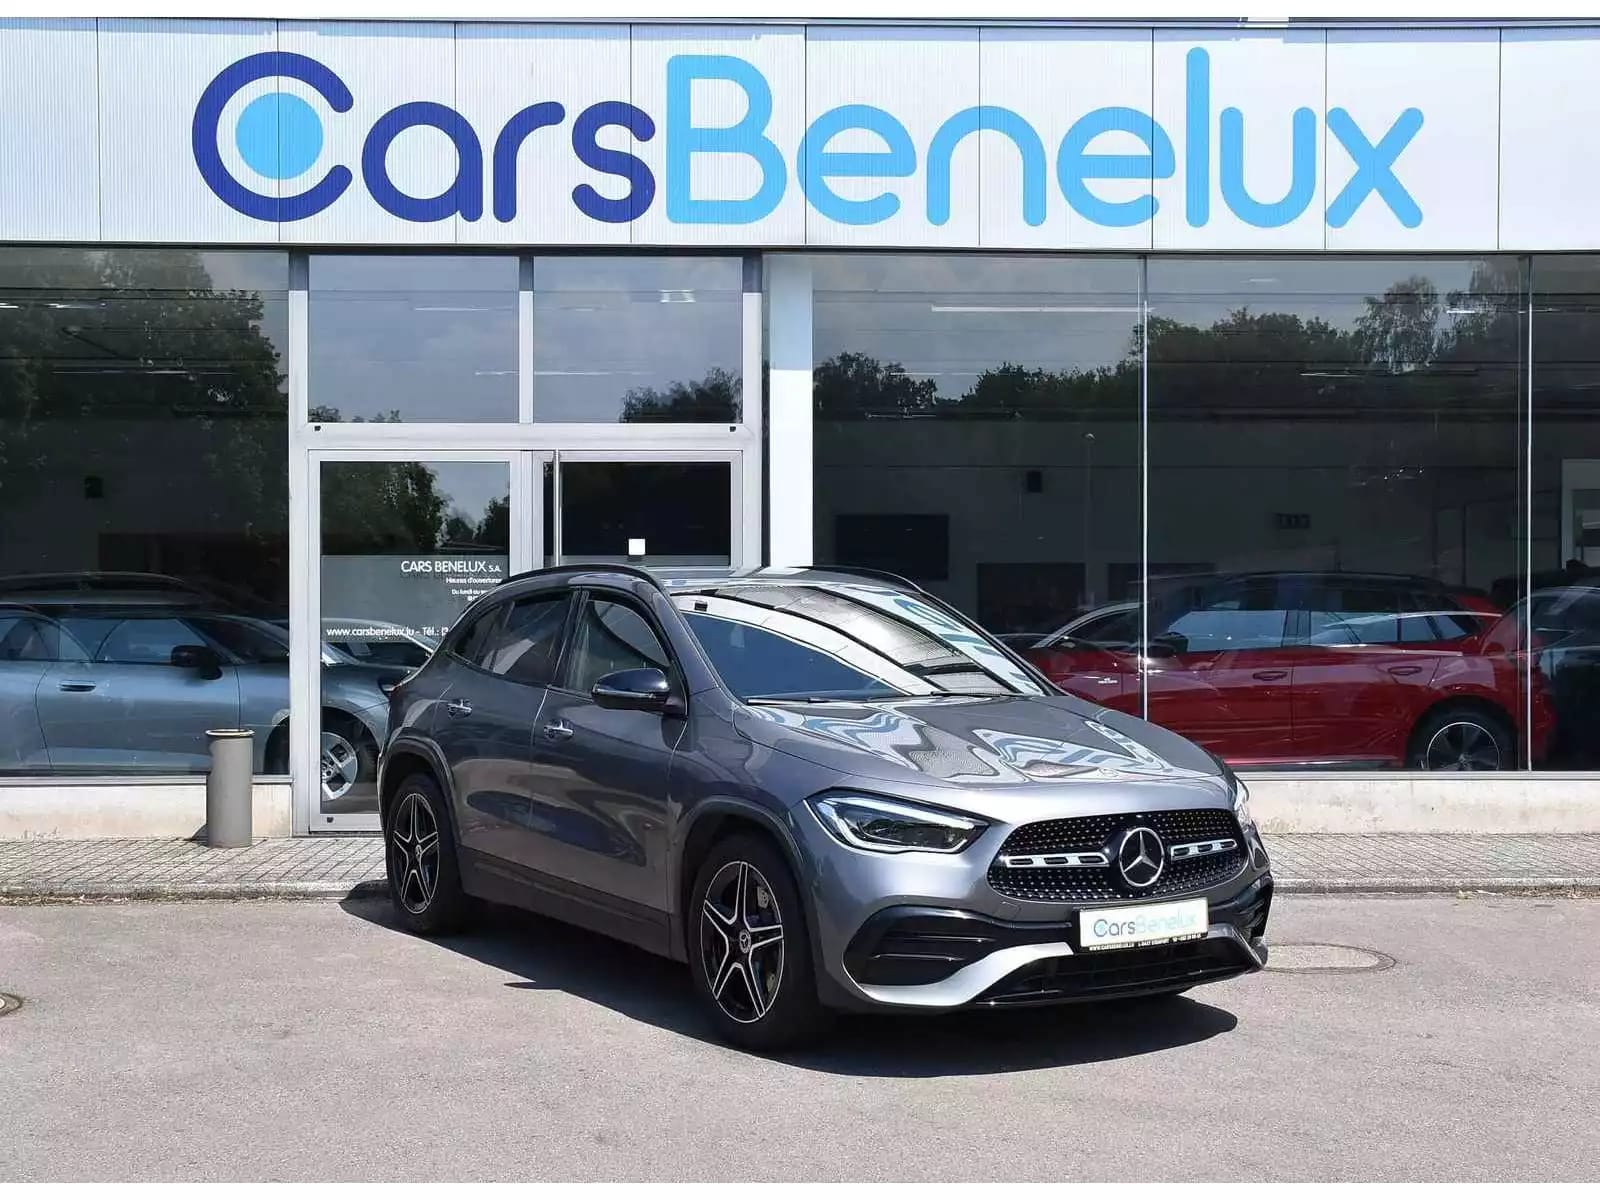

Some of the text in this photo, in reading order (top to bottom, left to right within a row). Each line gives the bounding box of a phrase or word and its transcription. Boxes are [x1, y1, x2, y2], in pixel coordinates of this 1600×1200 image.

[193, 48, 1424, 227] CarsBenelux
[401, 560, 432, 573] CARS
[435, 560, 487, 573] BENELUX
[326, 626, 415, 637] www.carsbenelux.lu
[1093, 908, 1197, 938] CarsBenelux
